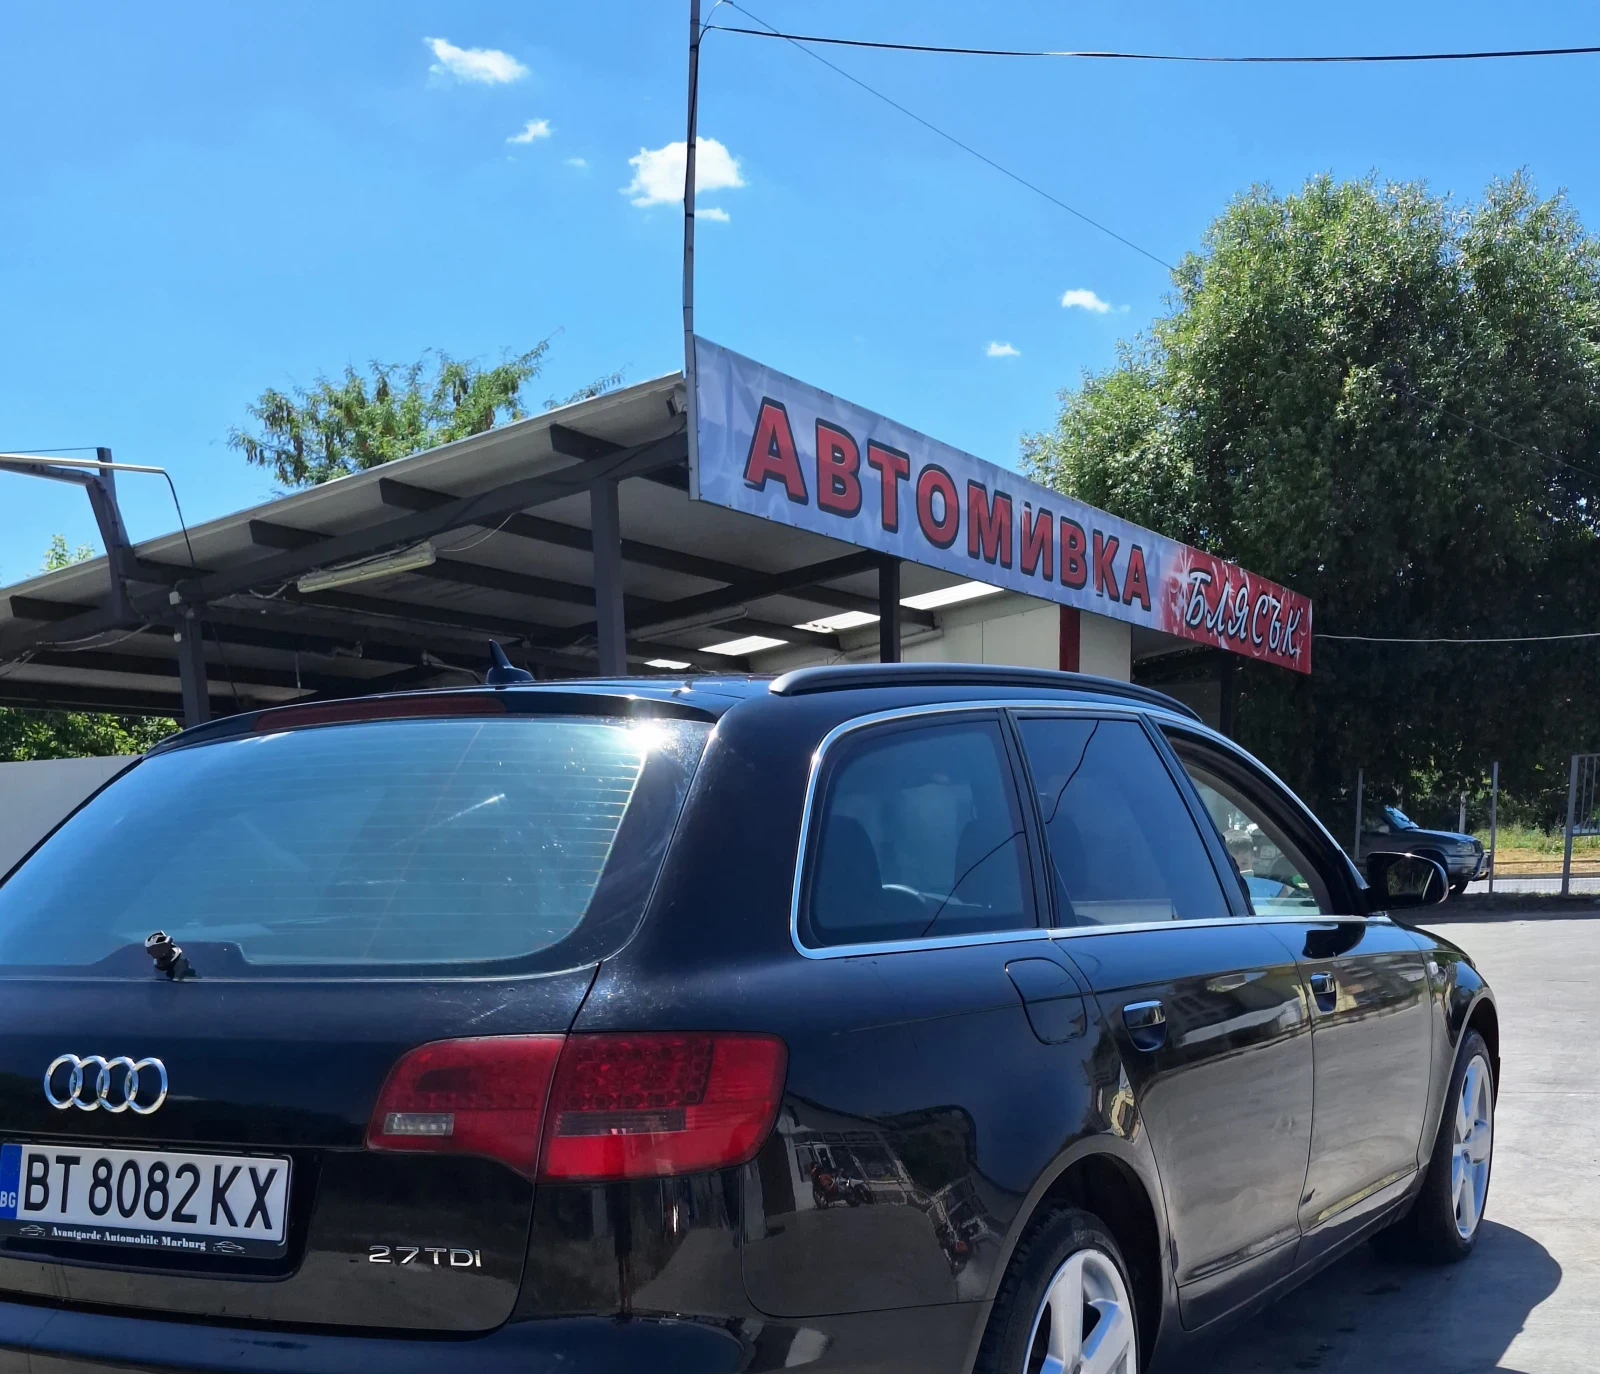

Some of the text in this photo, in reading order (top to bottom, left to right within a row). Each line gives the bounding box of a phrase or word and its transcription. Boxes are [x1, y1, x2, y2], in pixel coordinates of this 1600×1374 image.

[743, 397, 1152, 612] АВТОМИВКА
[0, 1191, 17, 1208] BG
[24, 1153, 278, 1230] BT 8082 KX
[51, 1226, 207, 1251] Avantgarde Automobile Marburg
